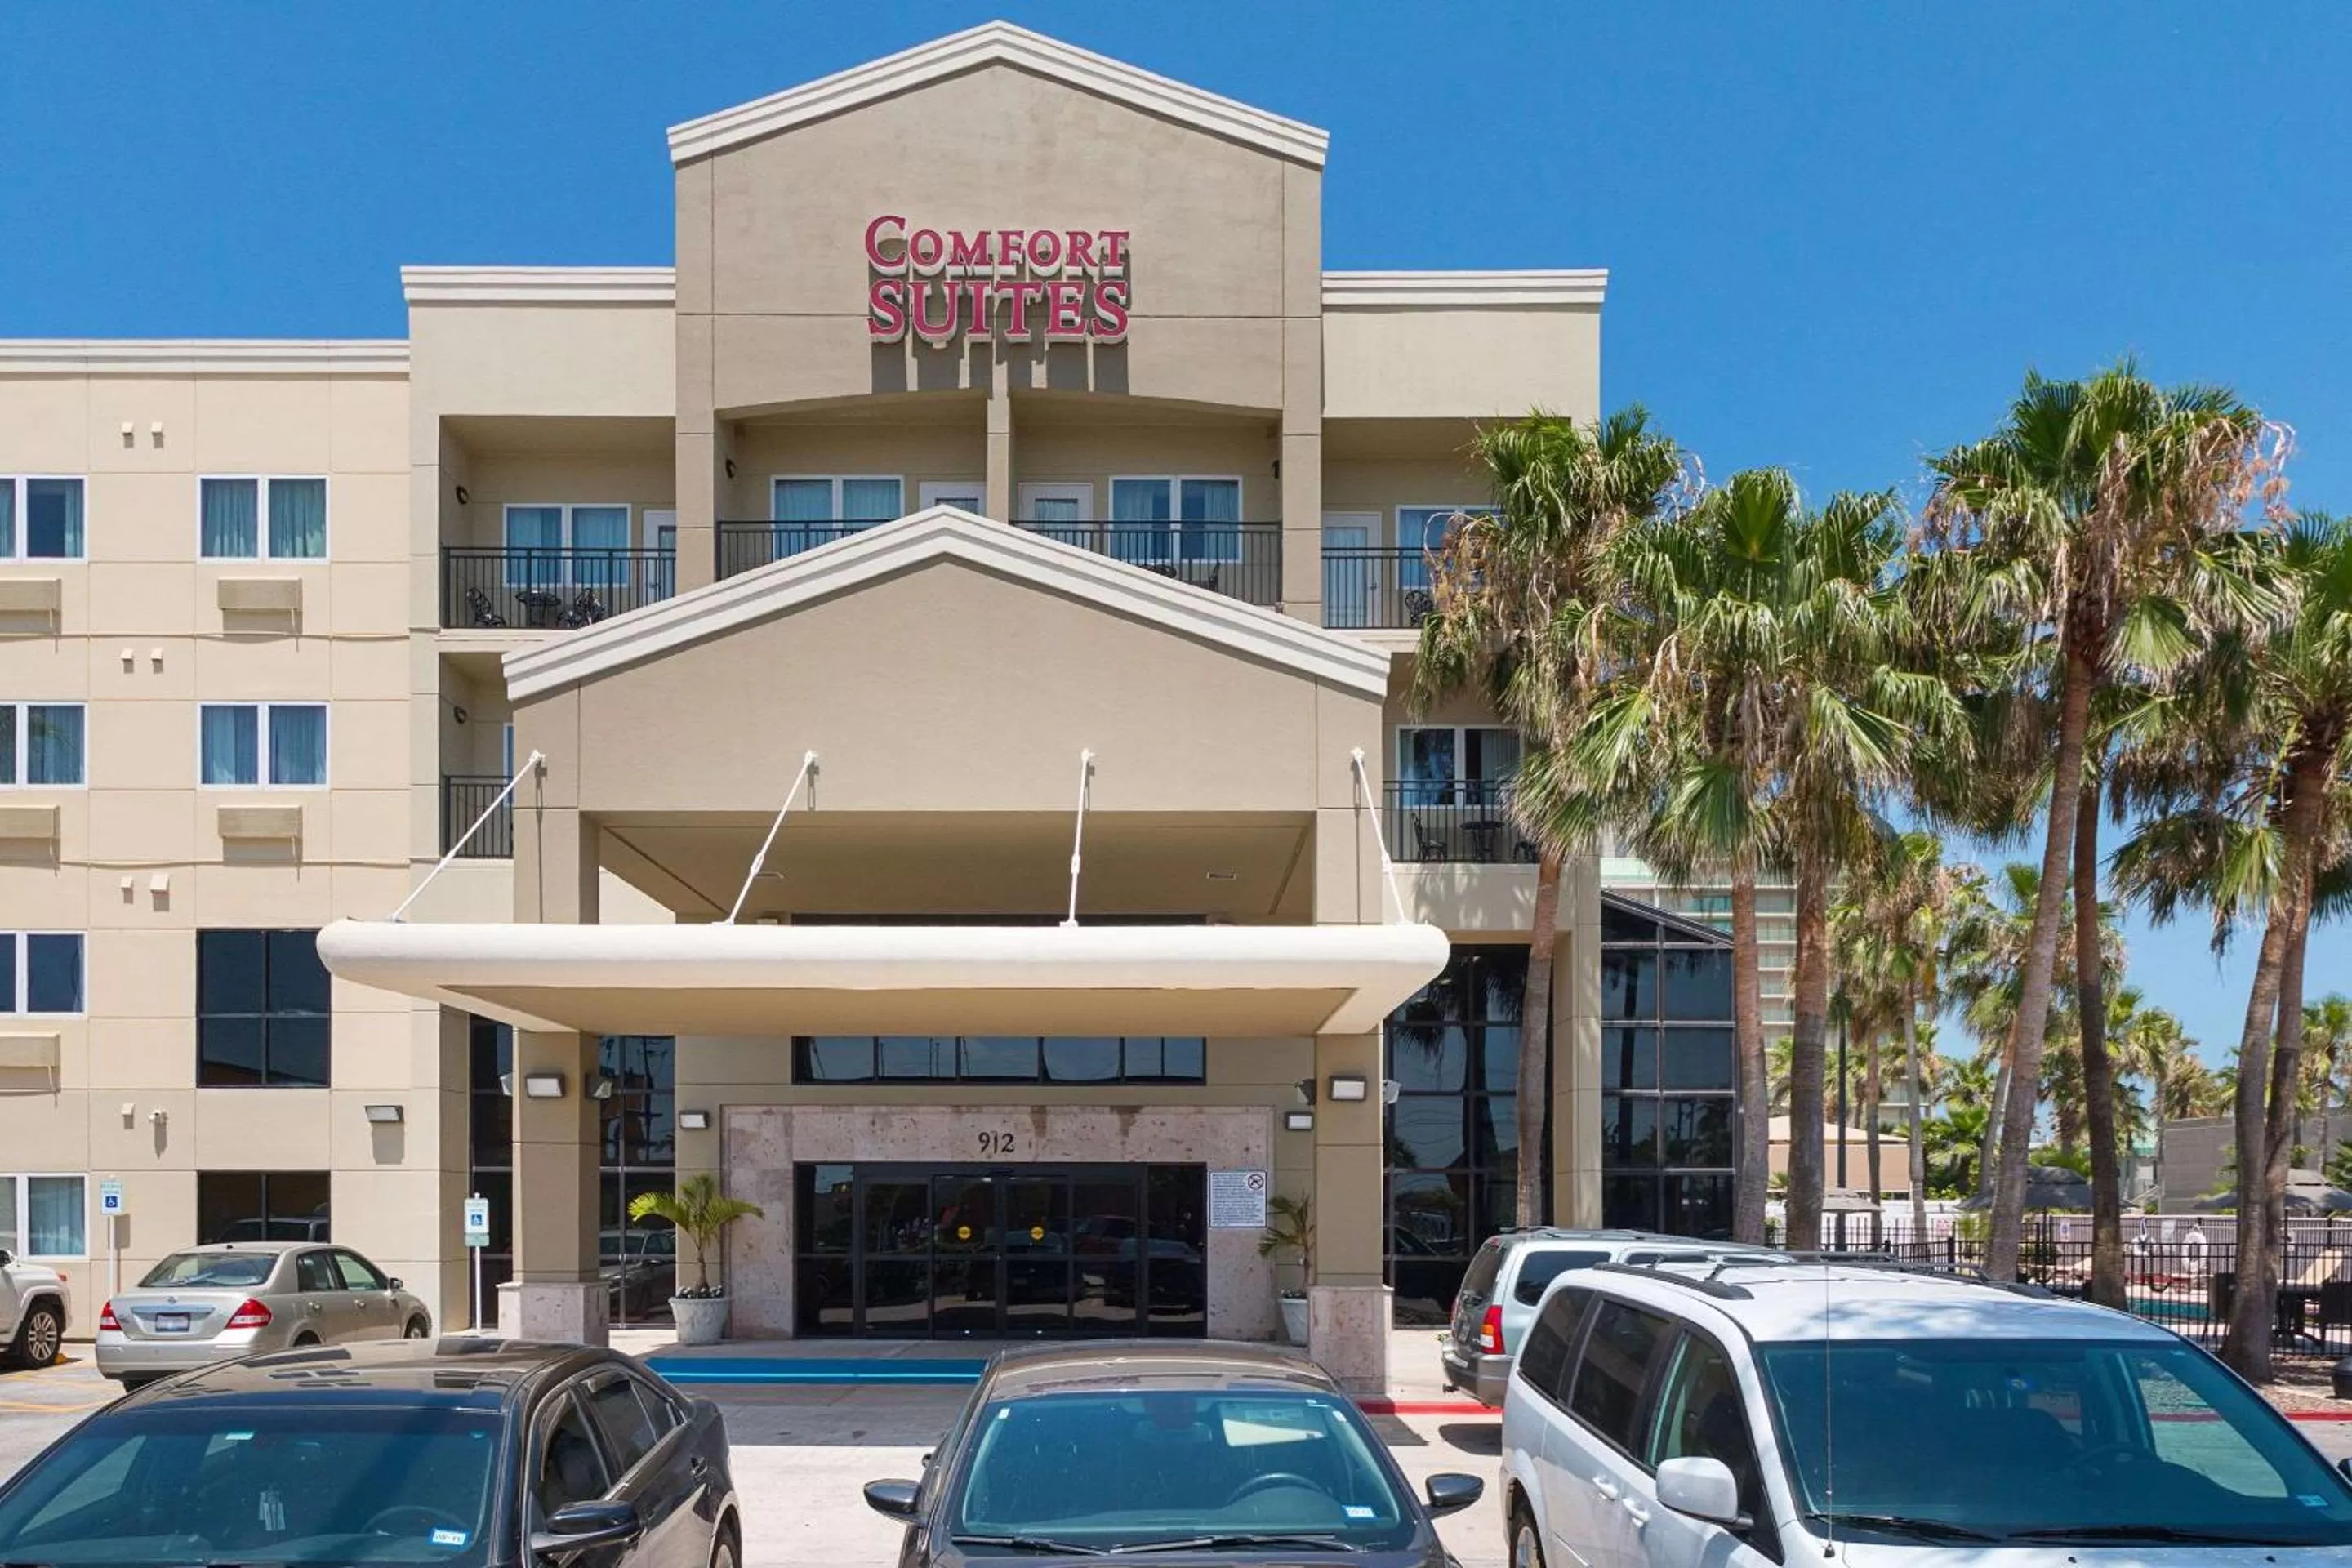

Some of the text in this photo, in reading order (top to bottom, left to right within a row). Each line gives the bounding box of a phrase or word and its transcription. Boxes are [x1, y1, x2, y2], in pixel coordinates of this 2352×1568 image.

[865, 215, 1130, 273] COMFORT
[867, 280, 1129, 342] SUITES
[978, 1132, 1015, 1153] 912
